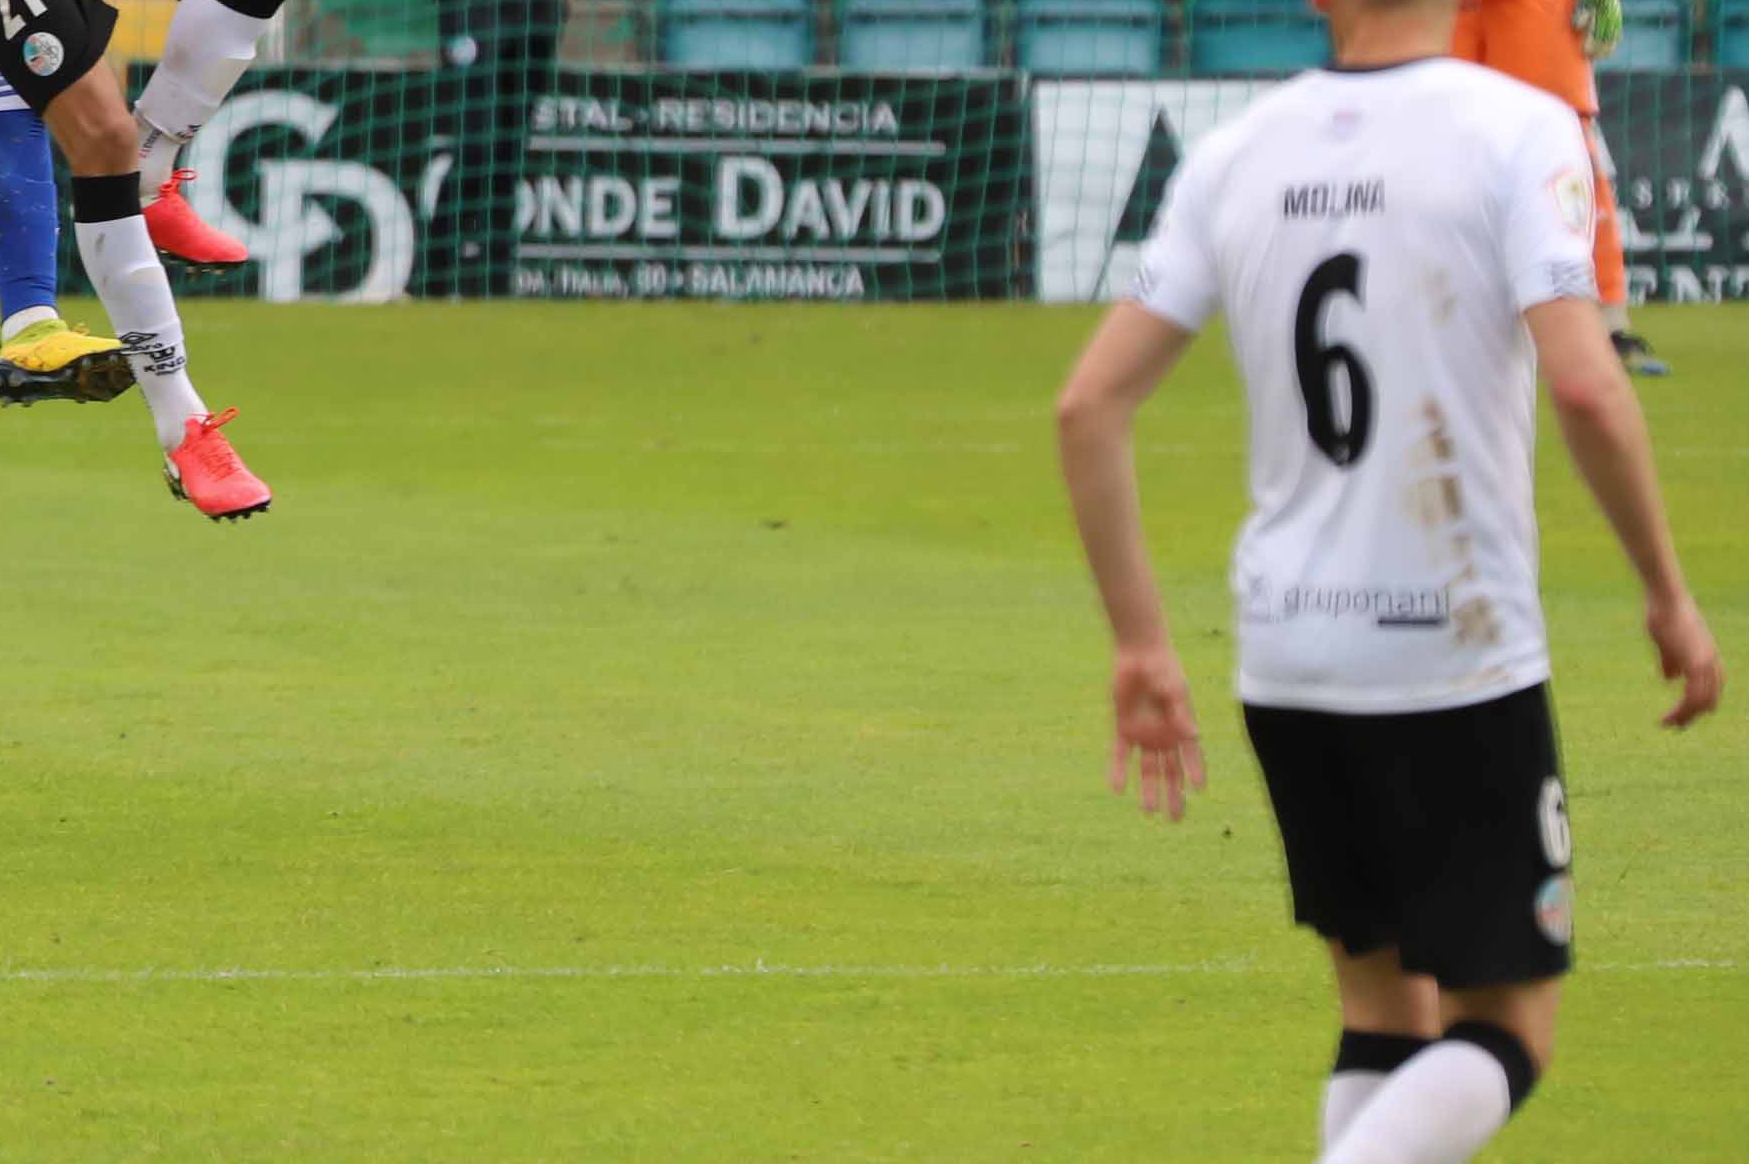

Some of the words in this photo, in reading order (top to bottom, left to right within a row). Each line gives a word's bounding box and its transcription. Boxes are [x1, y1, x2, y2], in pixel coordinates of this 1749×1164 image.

[657, 98, 899, 134] RESIDENCIA
[1295, 252, 1373, 468] 6
[1537, 775, 1572, 869] 6
